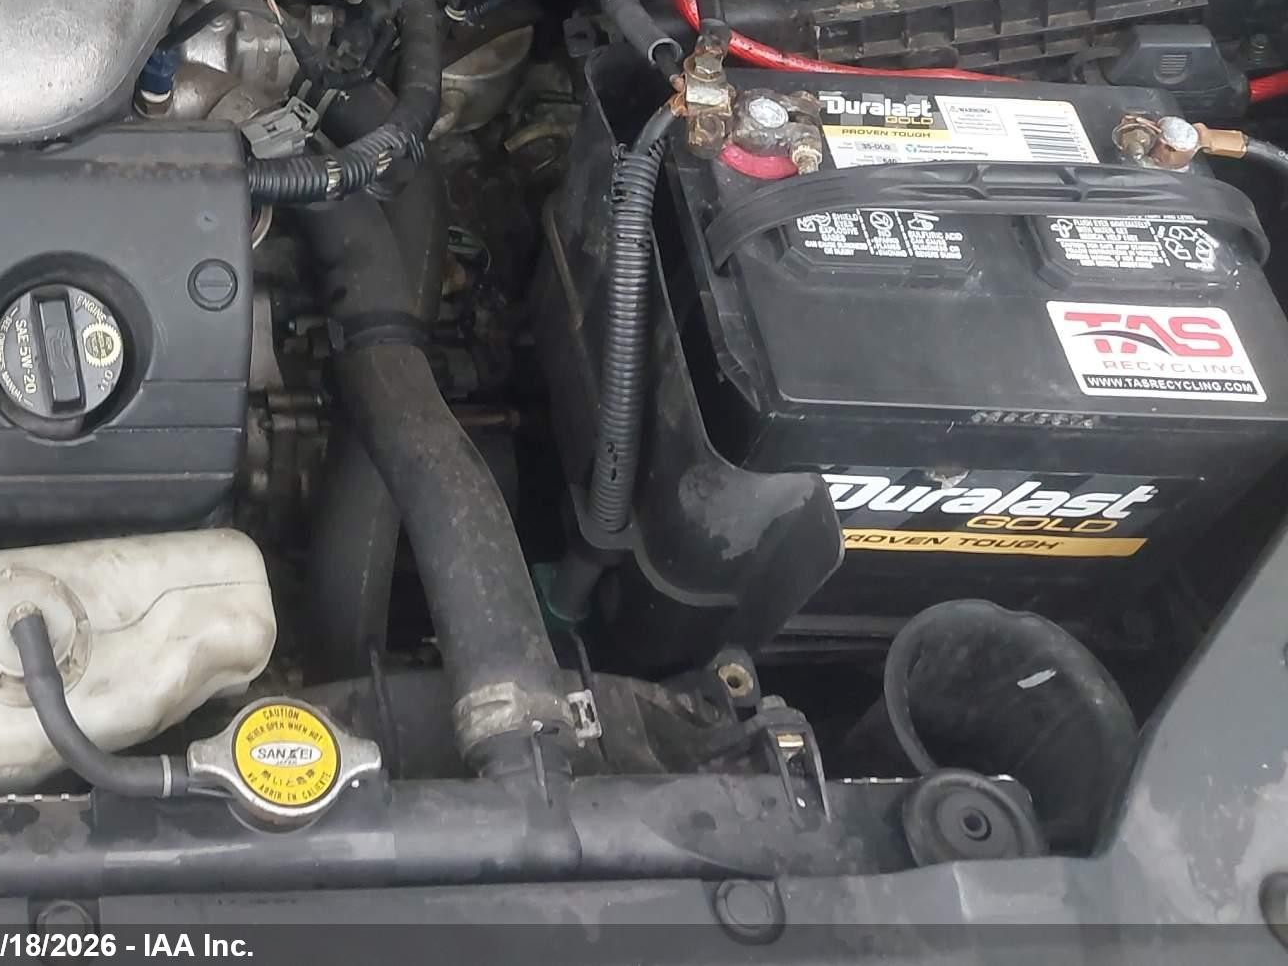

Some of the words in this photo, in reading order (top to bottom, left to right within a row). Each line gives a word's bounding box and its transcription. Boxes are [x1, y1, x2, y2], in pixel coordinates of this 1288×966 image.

[818, 93, 933, 118] Duralast
[884, 117, 934, 125] GOLD
[841, 128, 890, 136] PROVEN
[15, 319, 30, 348] SAE
[1064, 311, 1233, 358] TAS
[18, 347, 38, 395] 5W-20
[1102, 360, 1245, 375] RECYCLING
[1087, 376, 1254, 393] WWW.TASRECYCLING.COM
[821, 472, 1157, 519] Duralast
[965, 515, 1118, 533] GOLD
[844, 534, 950, 547] ROVEN
[959, 537, 1061, 550] TOUGH
[262, 708, 300, 721] CAUTION
[267, 721, 285, 731] OPEN
[288, 721, 307, 735] WHEN
